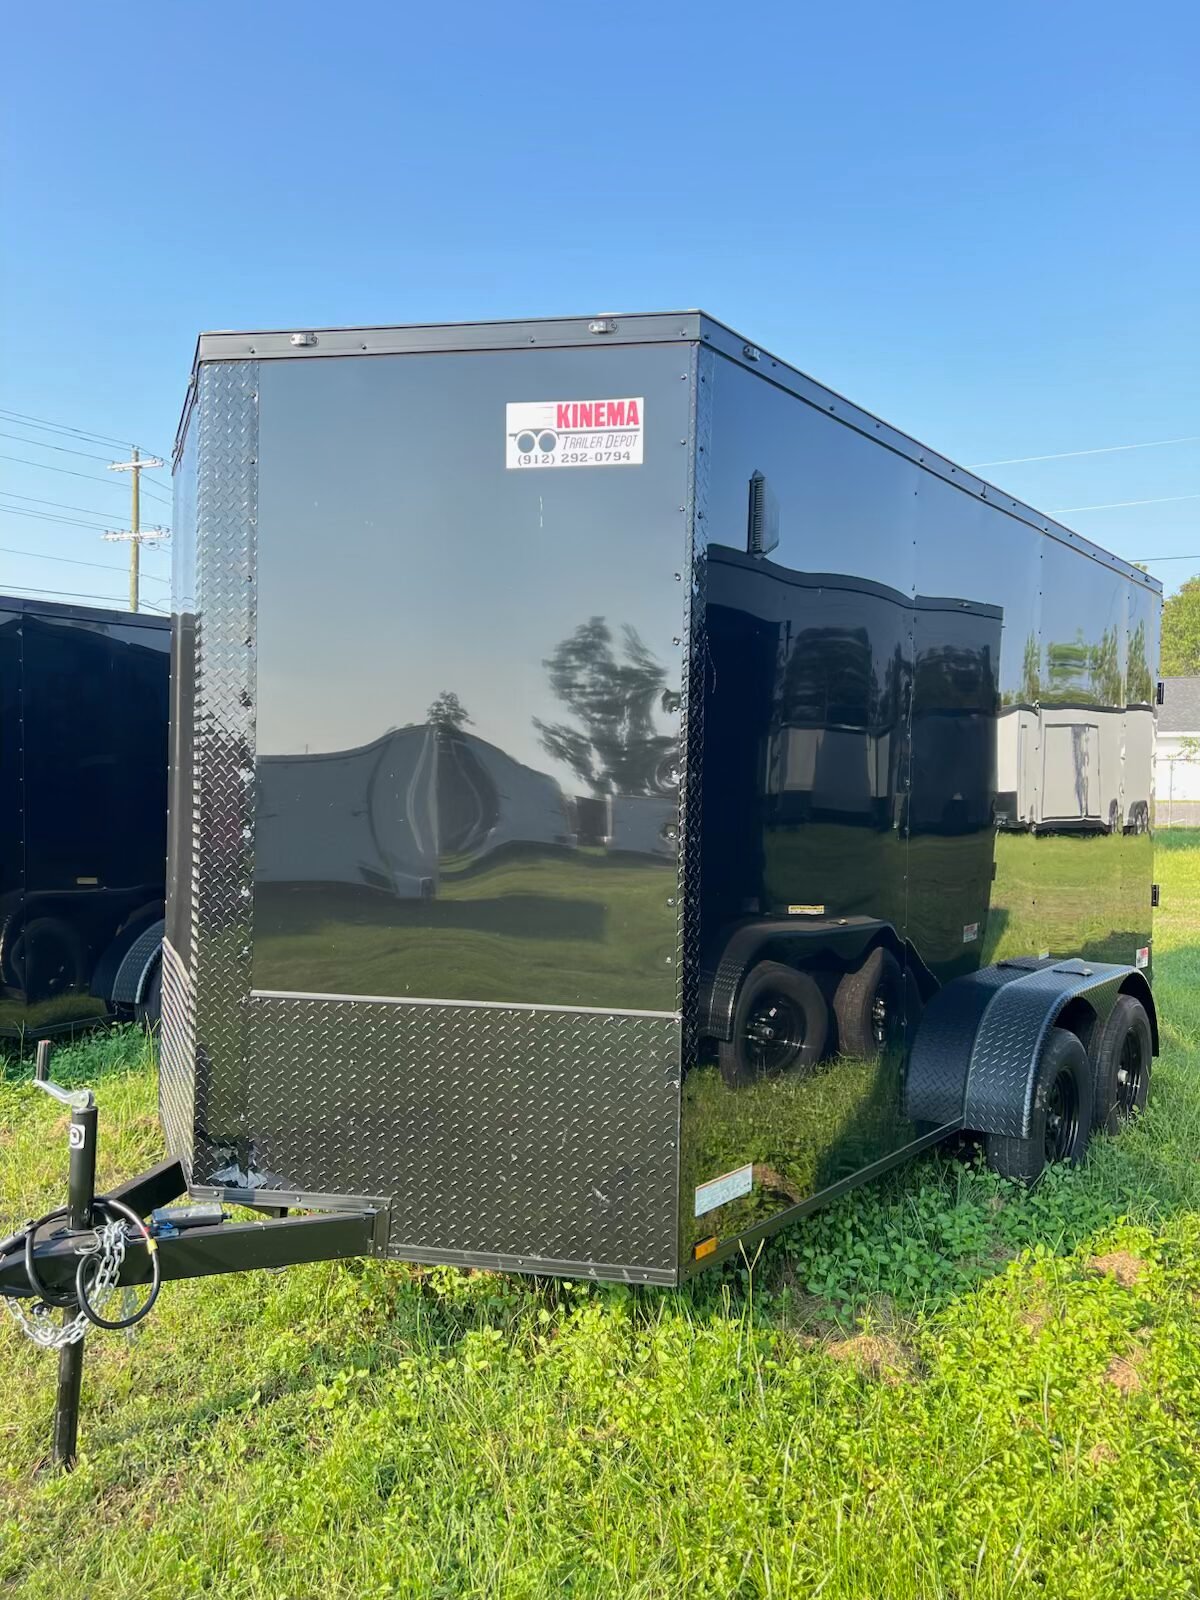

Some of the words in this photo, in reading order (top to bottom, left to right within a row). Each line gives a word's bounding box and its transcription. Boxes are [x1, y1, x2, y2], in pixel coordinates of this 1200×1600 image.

[556, 400, 639, 428] KINEMA
[563, 436, 602, 449] TRAILER
[605, 434, 638, 448] DEPOT
[518, 454, 555, 466] (912)
[561, 451, 631, 464] 292-0794
